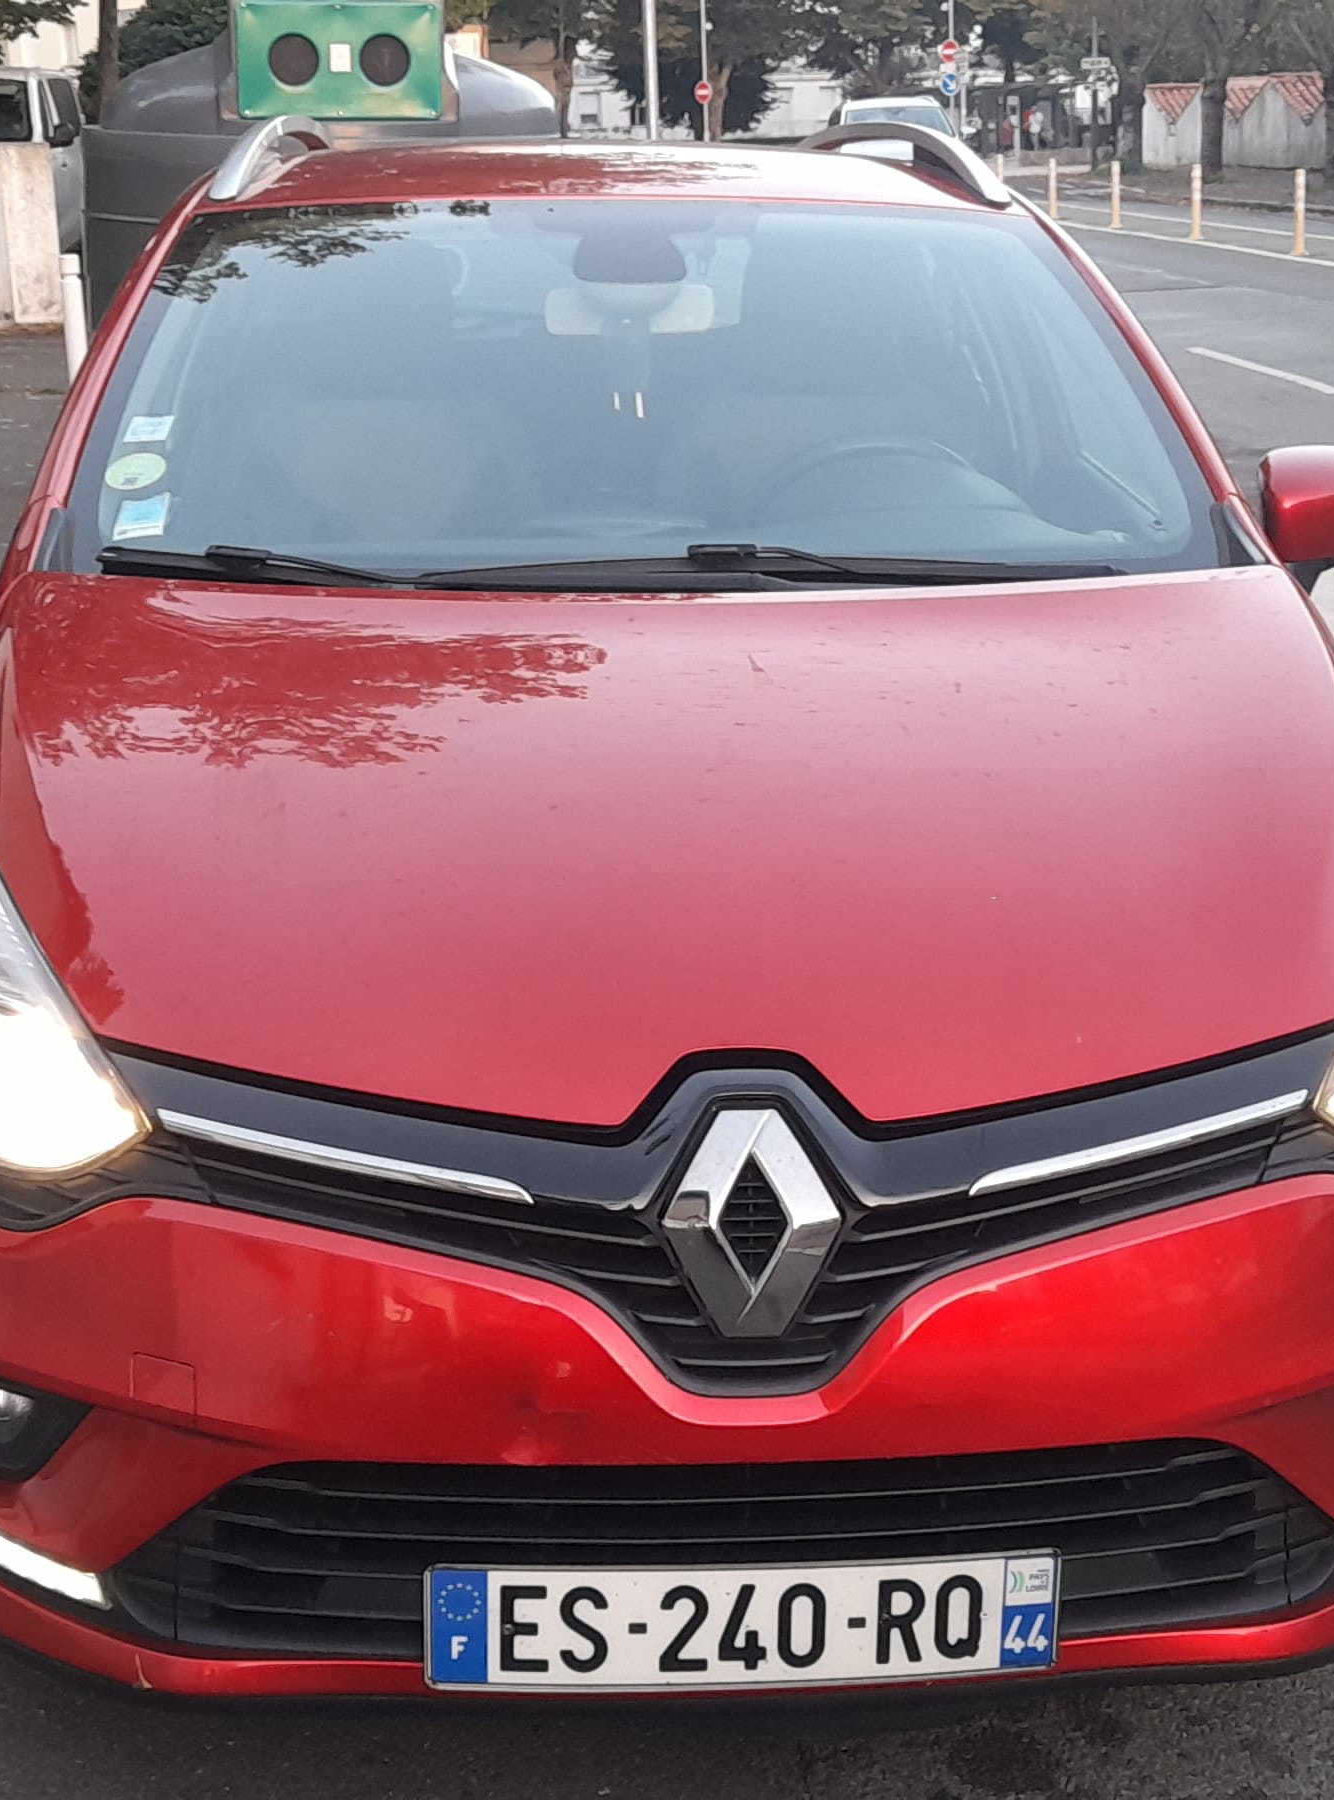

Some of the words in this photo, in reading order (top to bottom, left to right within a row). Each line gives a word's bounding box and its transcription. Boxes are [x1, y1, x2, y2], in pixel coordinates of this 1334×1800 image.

[499, 1574, 984, 1673] ES-240-RQ
[1004, 1613, 1049, 1654] 44
[450, 1636, 468, 1660] F
